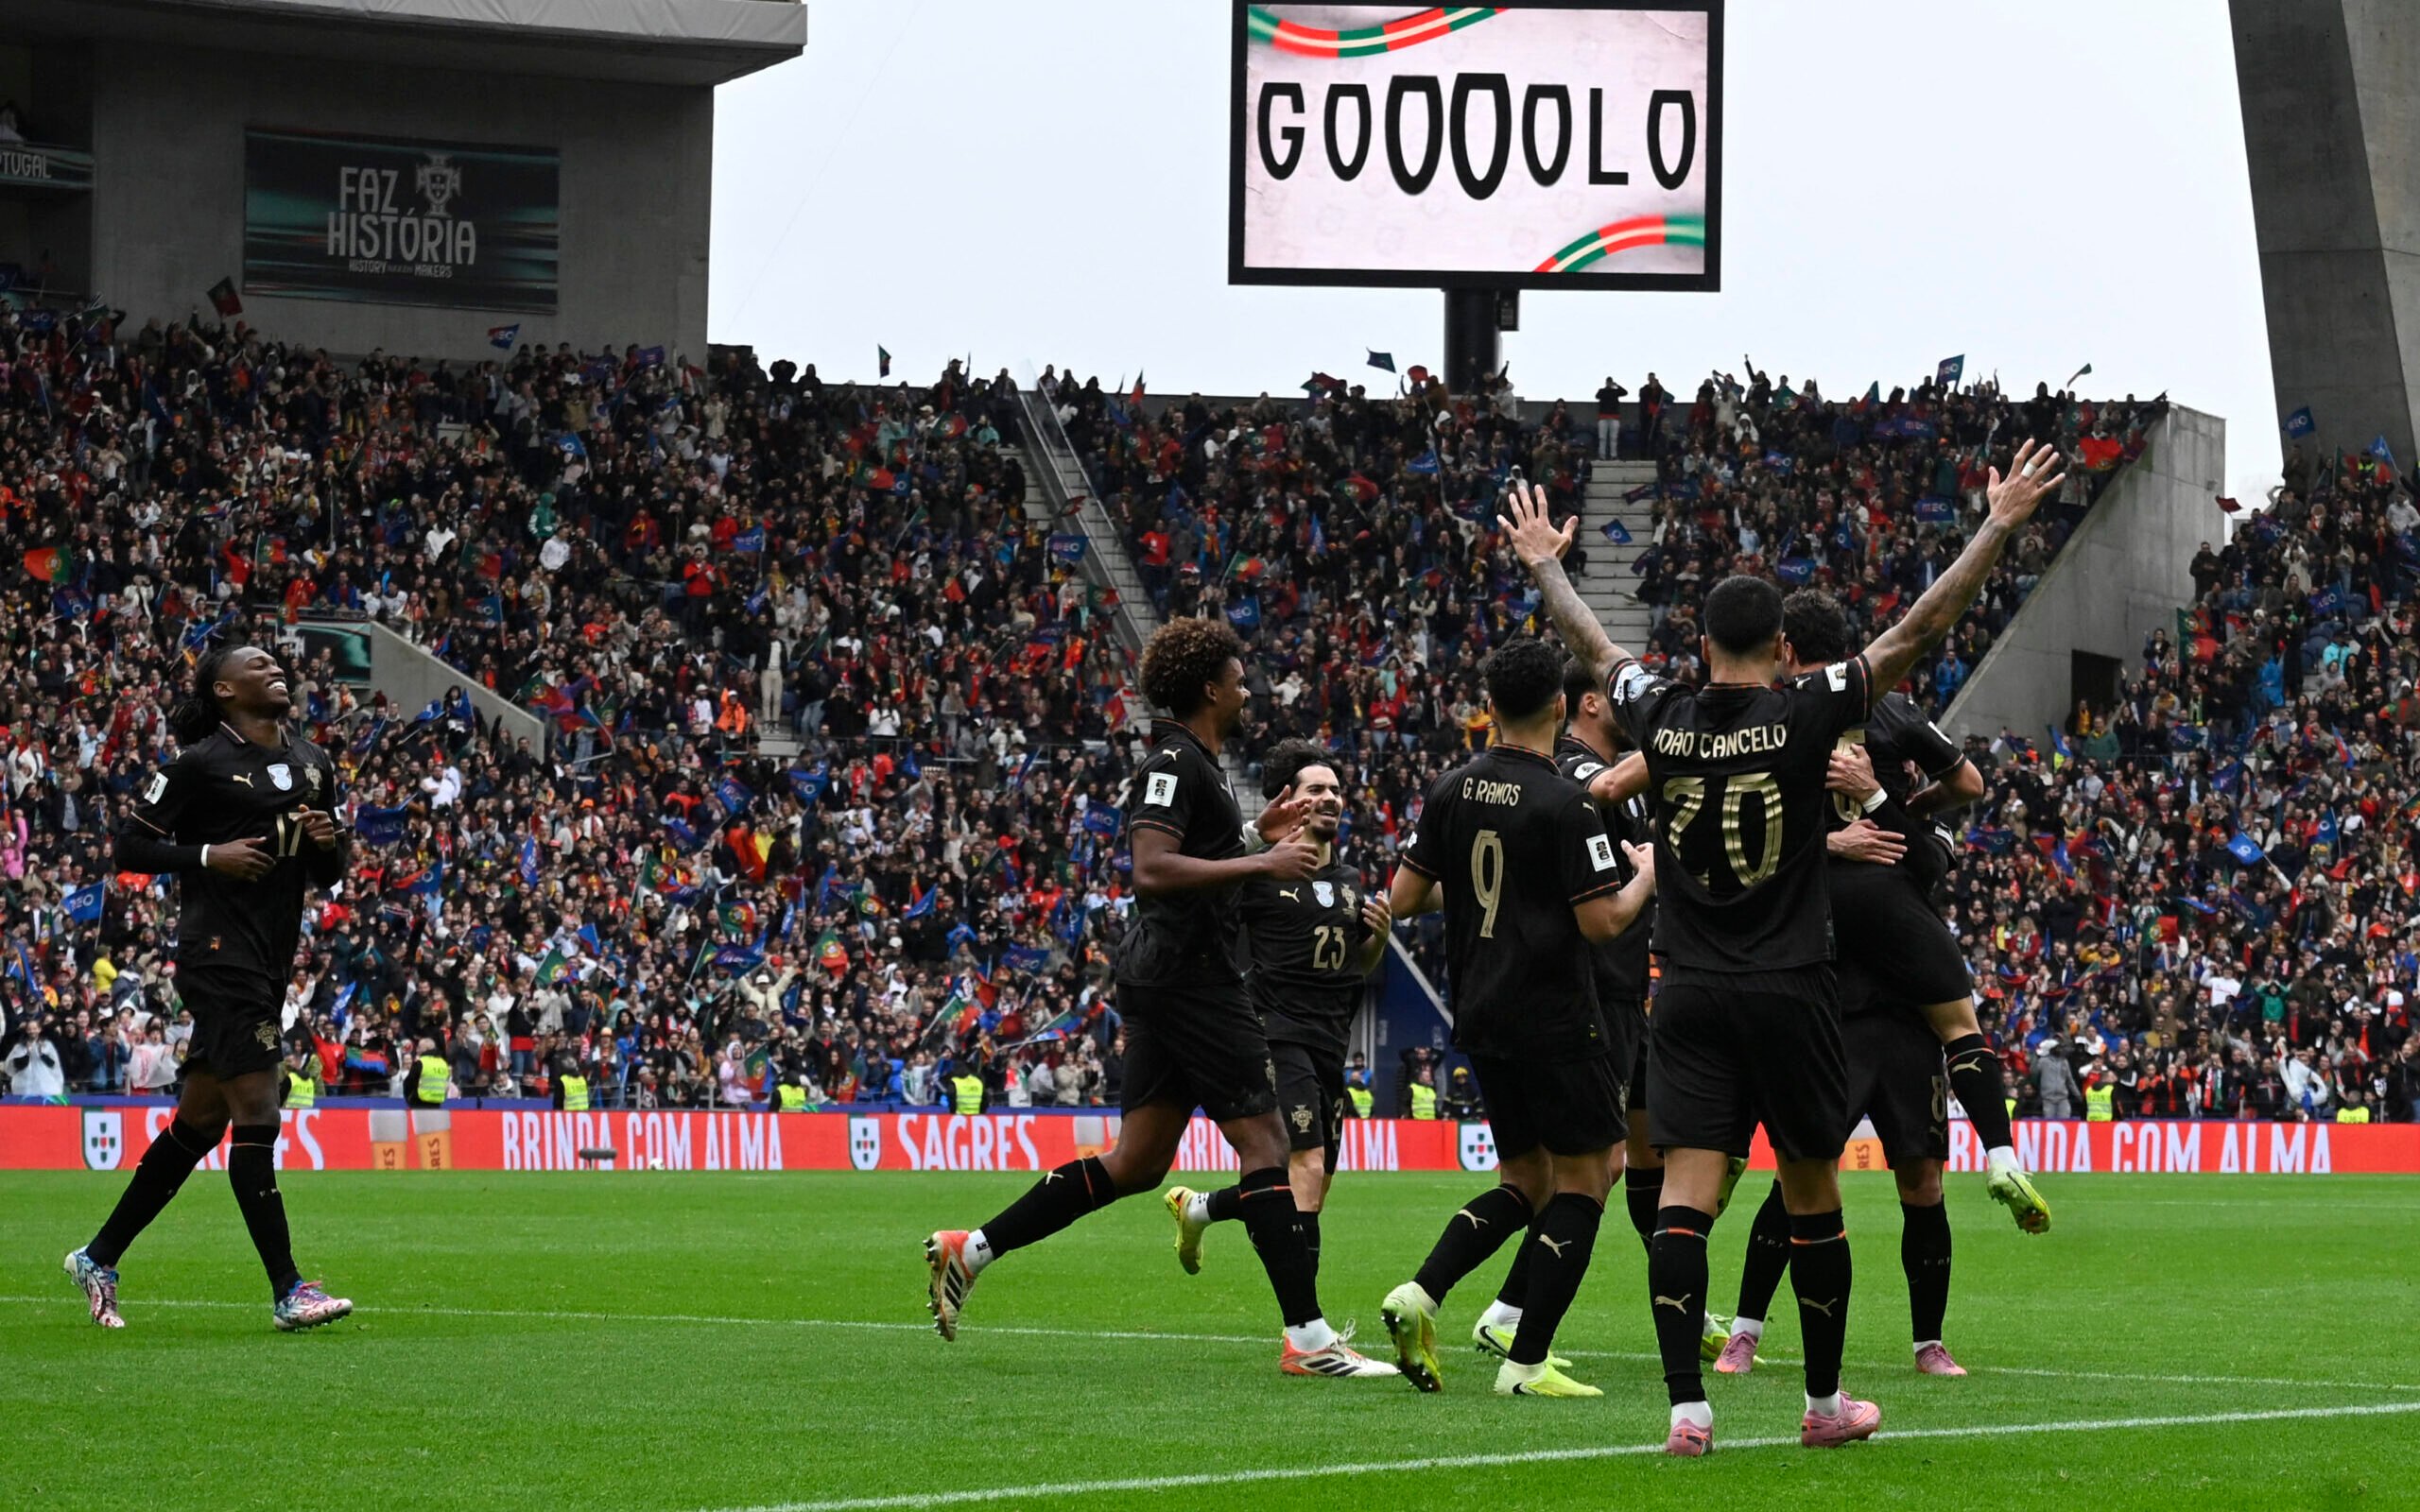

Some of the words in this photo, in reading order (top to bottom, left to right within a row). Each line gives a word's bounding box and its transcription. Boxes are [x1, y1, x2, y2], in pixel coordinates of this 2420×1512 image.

[1257, 73, 1696, 199] GOOOOLO
[0, 152, 52, 179] TUGAL
[340, 166, 399, 215] FAZ
[328, 207, 476, 265] HISTÓRIA
[1652, 727, 1694, 756] JOÃO
[1700, 724, 1787, 759] CANCELO
[1462, 778, 1473, 800] G.
[1475, 781, 1521, 806] RAMOS
[276, 813, 302, 857] 17
[1663, 772, 1783, 888] 20
[1471, 830, 1504, 938] 9
[1313, 925, 1346, 971] 23
[502, 1111, 614, 1170] BRINDA
[627, 1112, 692, 1170] COM
[704, 1113, 783, 1170] ALMA
[897, 1113, 1039, 1171] SAGRES
[2112, 1123, 2200, 1173] COM
[2219, 1124, 2332, 1174] ALMA
